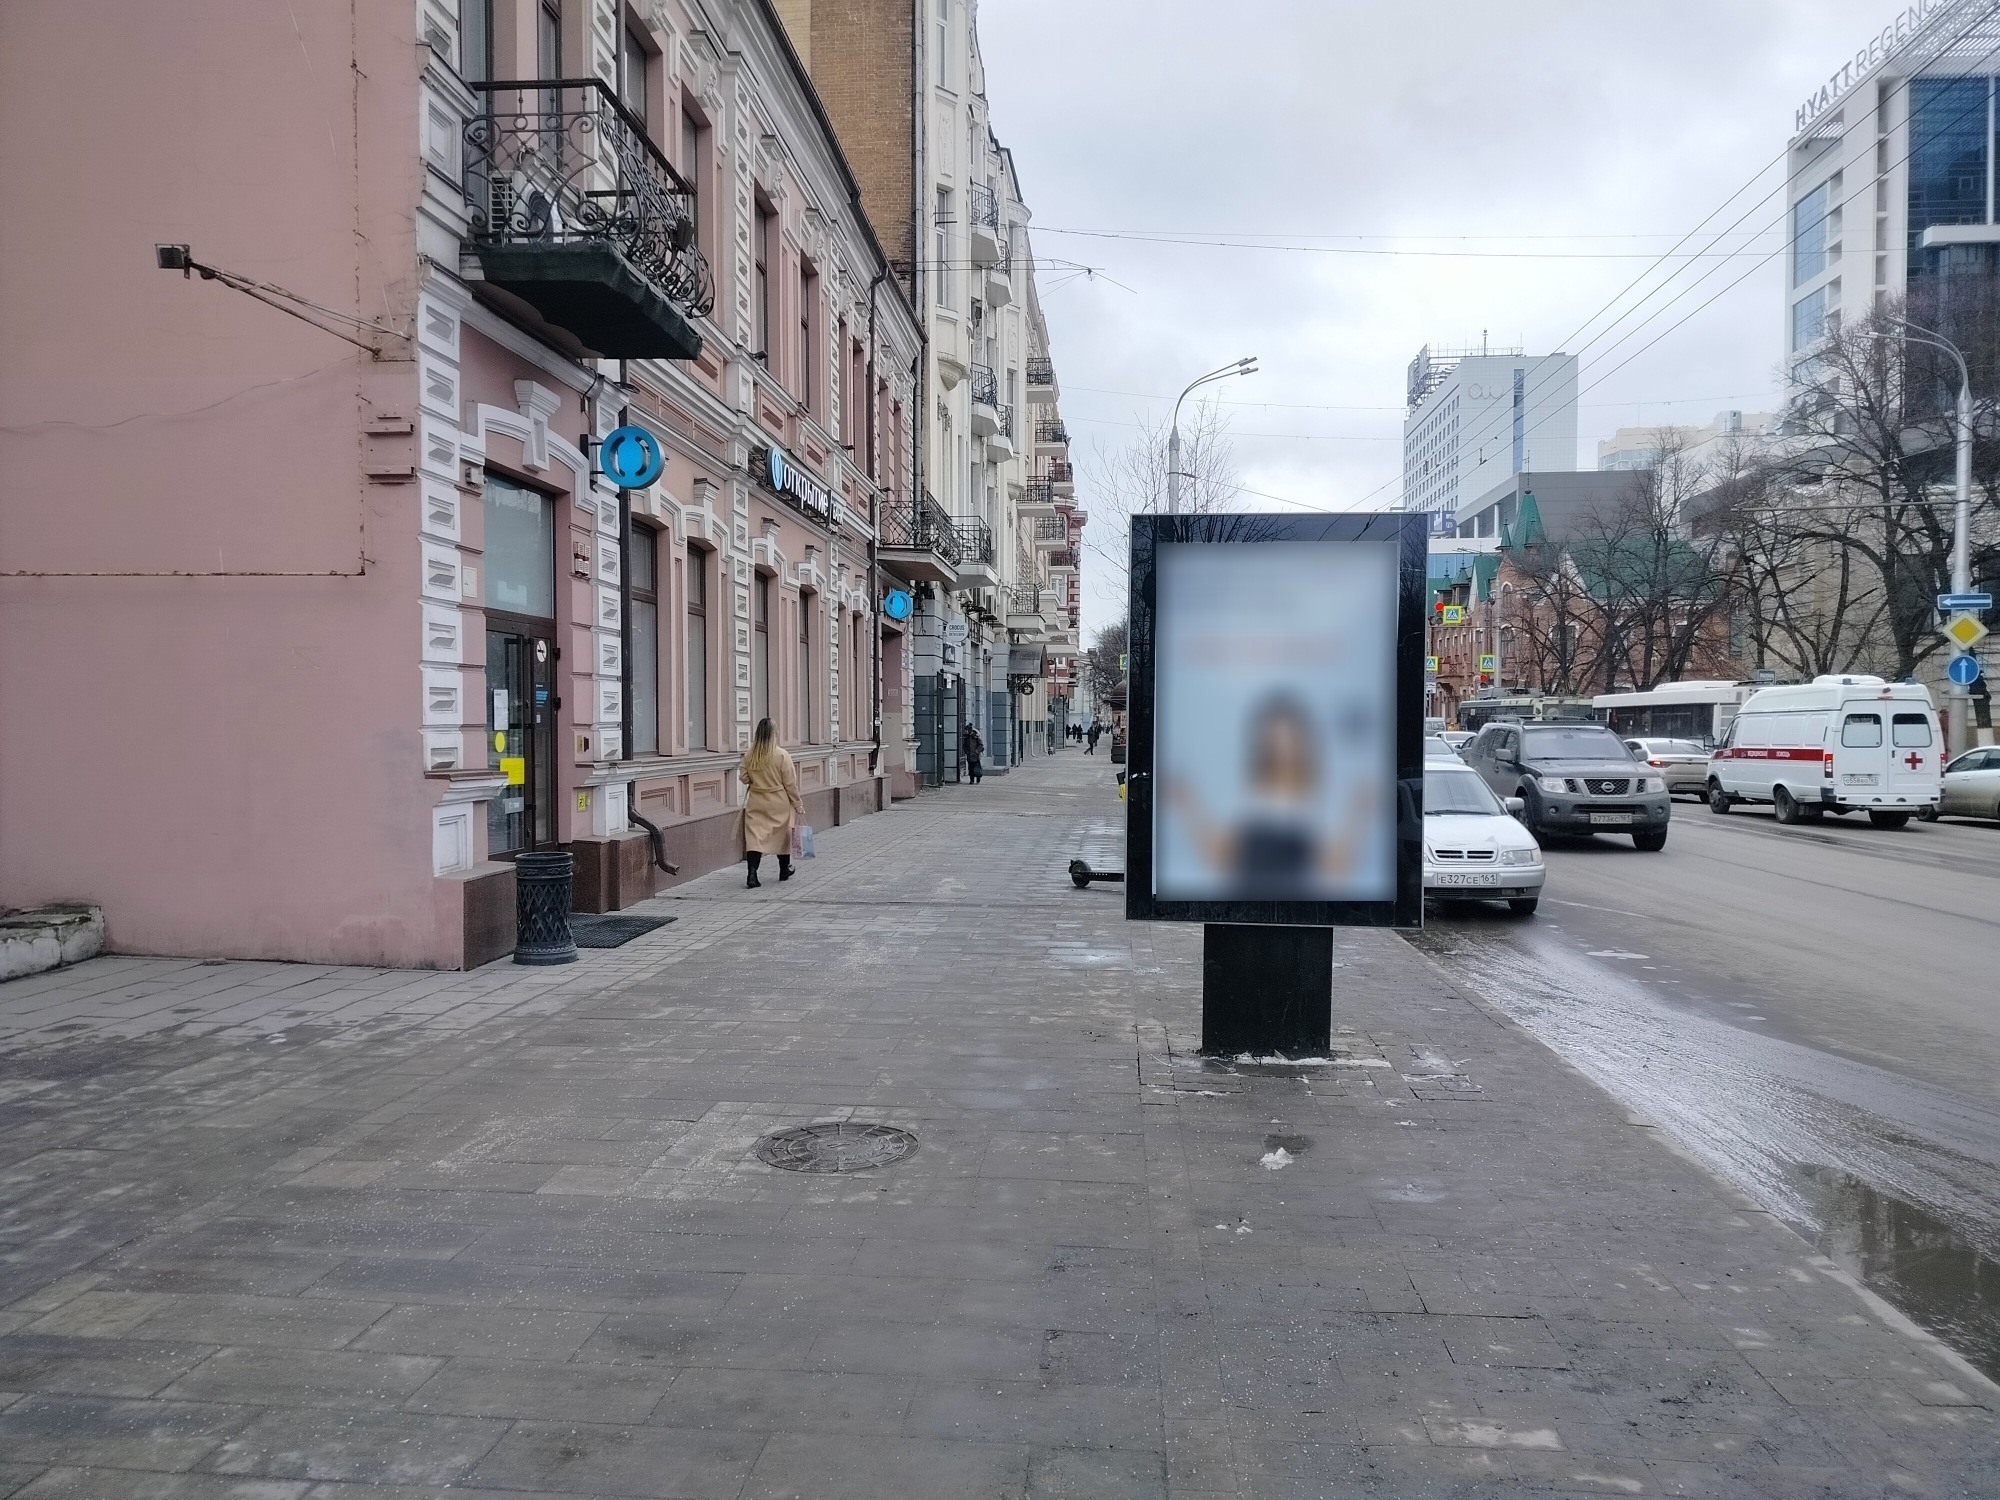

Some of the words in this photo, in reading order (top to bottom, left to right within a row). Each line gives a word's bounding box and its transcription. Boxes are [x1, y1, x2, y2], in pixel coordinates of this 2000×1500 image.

[1795, 60, 1853, 132] HYATT
[1855, 0, 1948, 77] REGENC
[1481, 874, 1496, 882] 161
